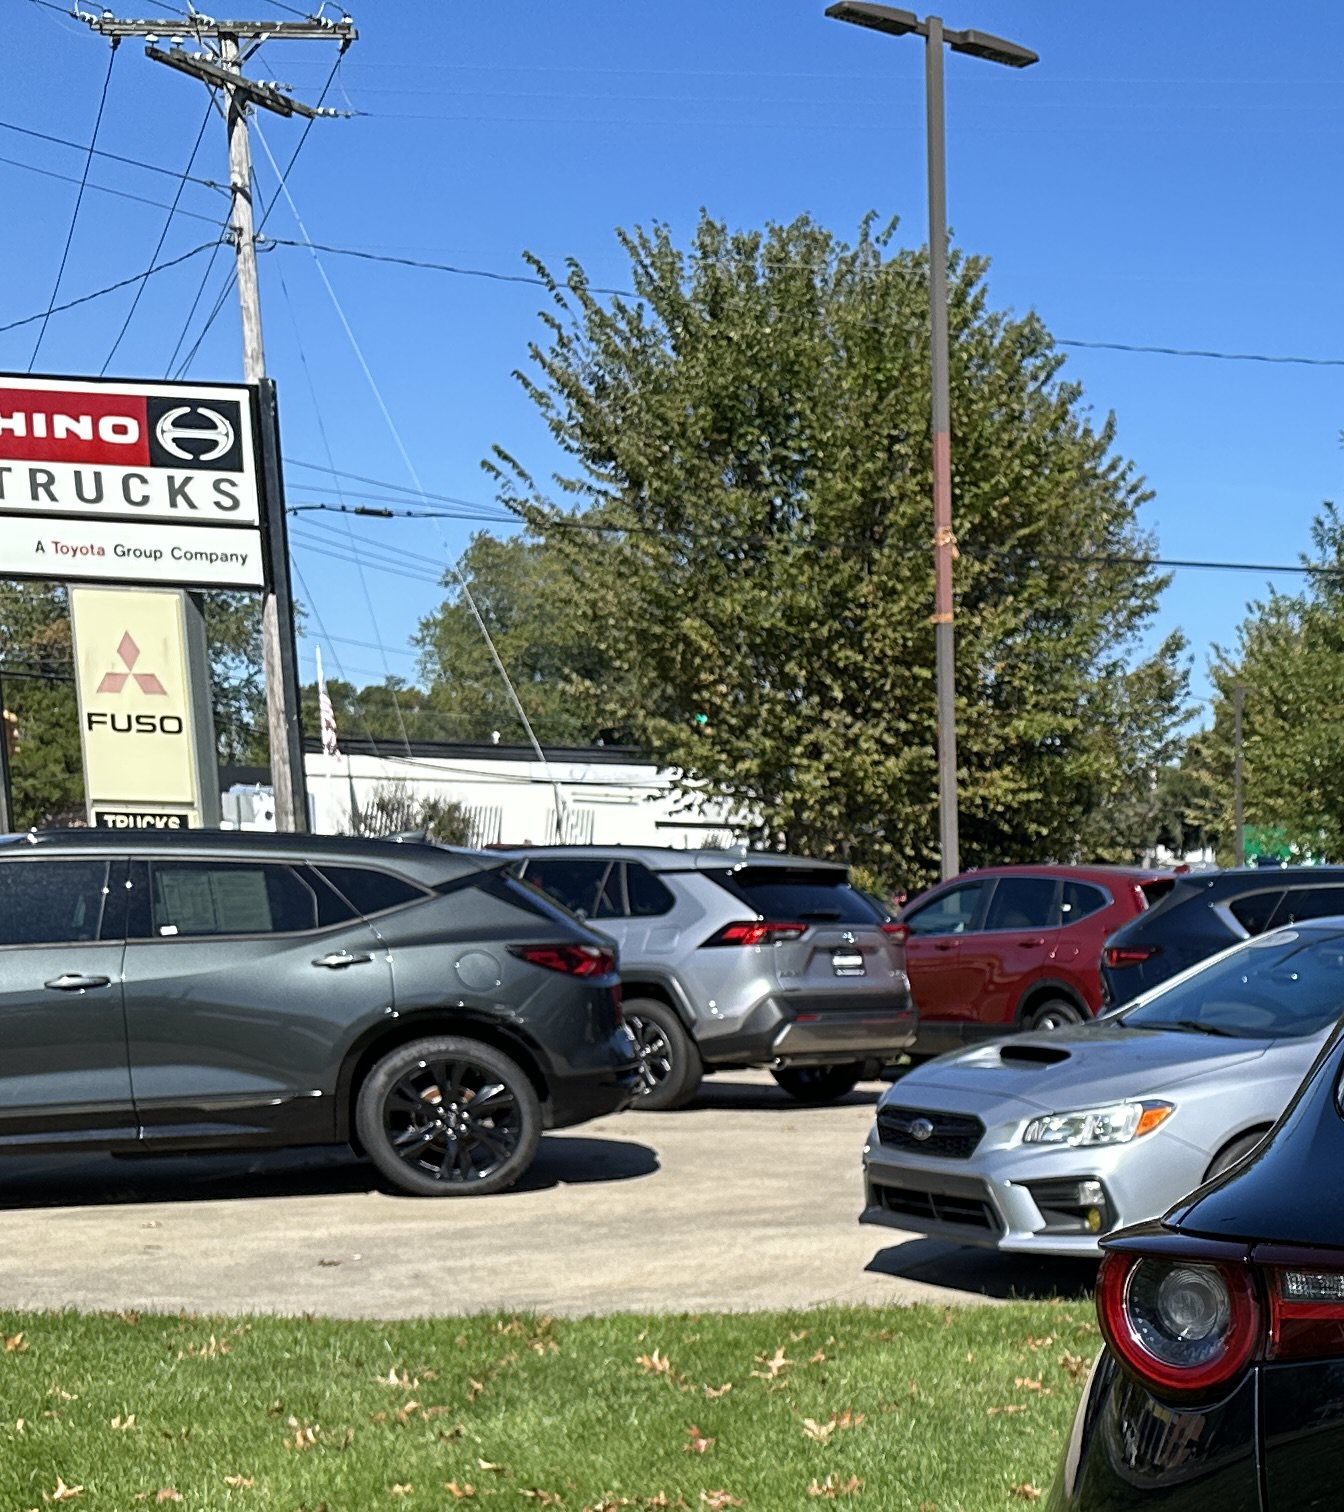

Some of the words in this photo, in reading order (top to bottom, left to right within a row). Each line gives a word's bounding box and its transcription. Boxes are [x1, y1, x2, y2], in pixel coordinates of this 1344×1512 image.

[0, 411, 139, 444] HINO
[35, 540, 45, 553] A
[51, 541, 106, 558] Toyota
[113, 544, 163, 560] Group
[171, 546, 248, 566] Company
[87, 712, 183, 735] FUSO
